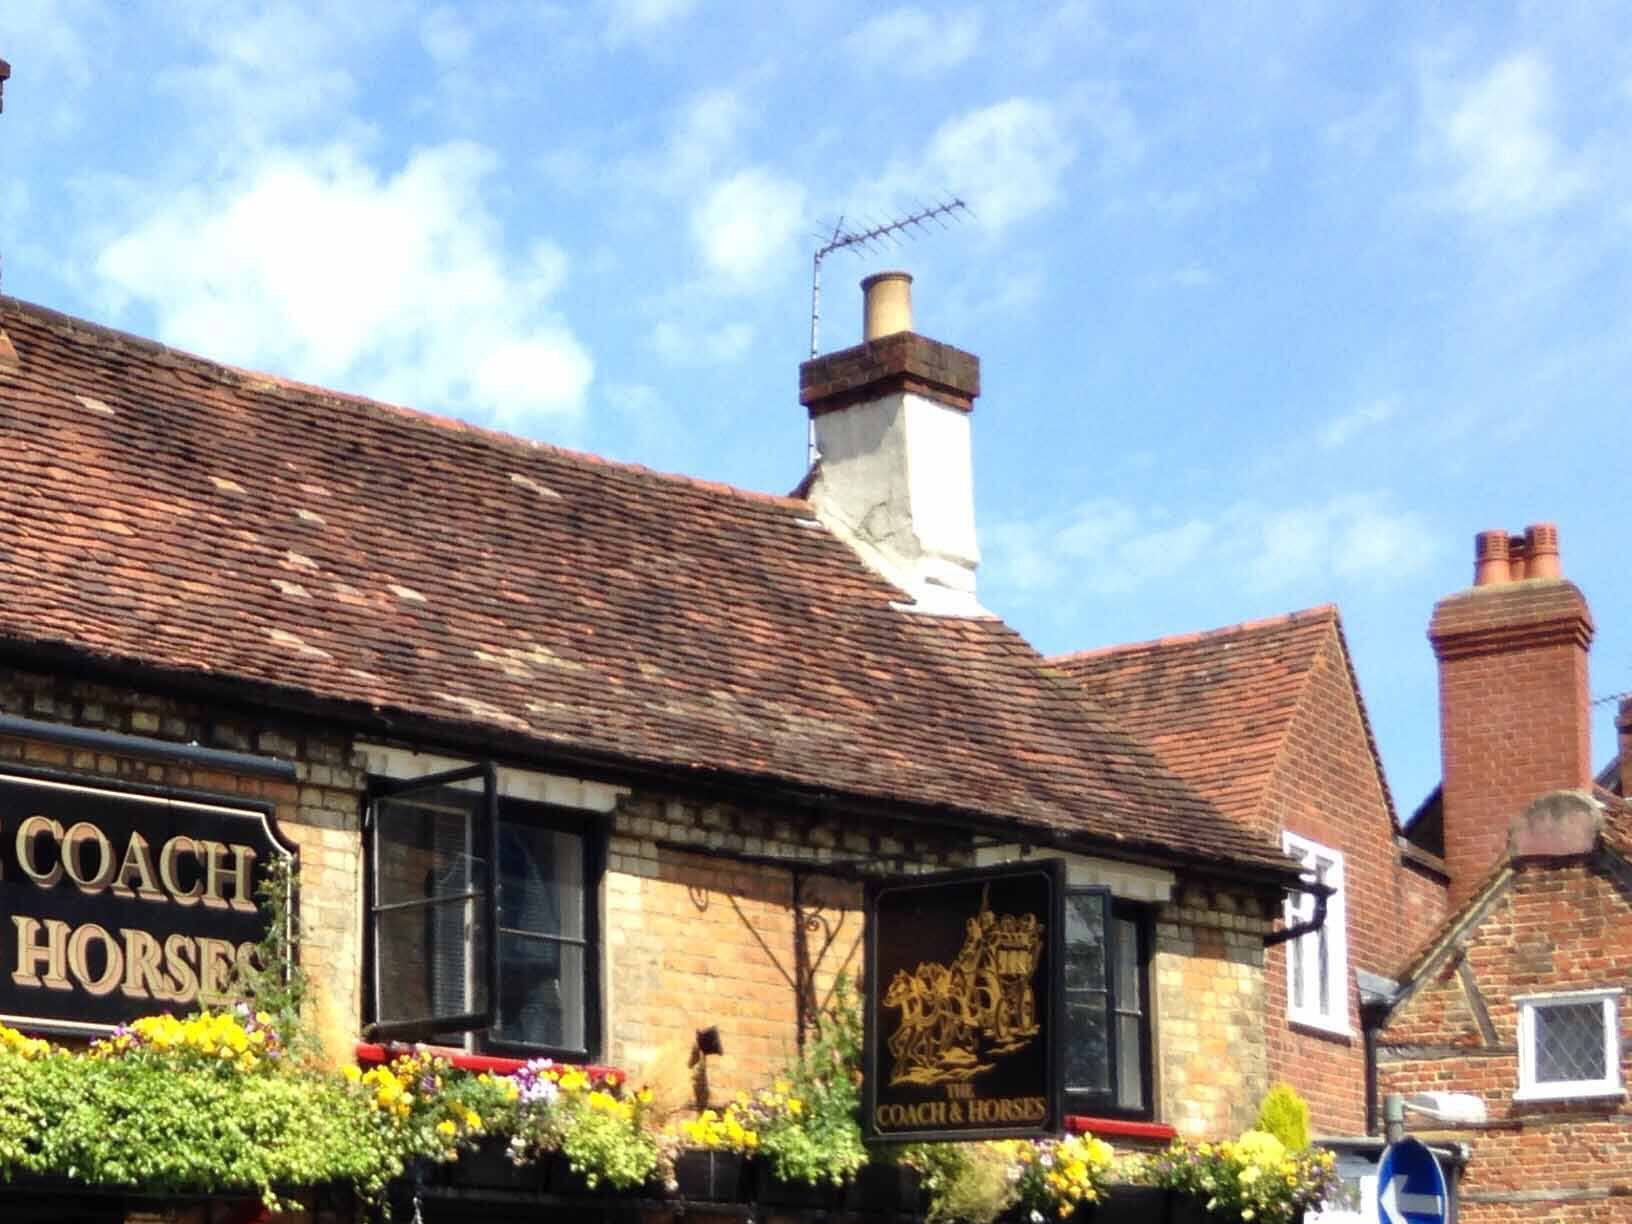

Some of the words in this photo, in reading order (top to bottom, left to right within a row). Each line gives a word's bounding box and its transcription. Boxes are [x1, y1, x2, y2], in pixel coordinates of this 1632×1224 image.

[16, 815, 258, 913] COACH
[12, 914, 264, 1007] HORSES
[876, 1101, 947, 1126] COACH
[948, 1101, 964, 1123] &
[968, 1096, 1048, 1123] HORSES
